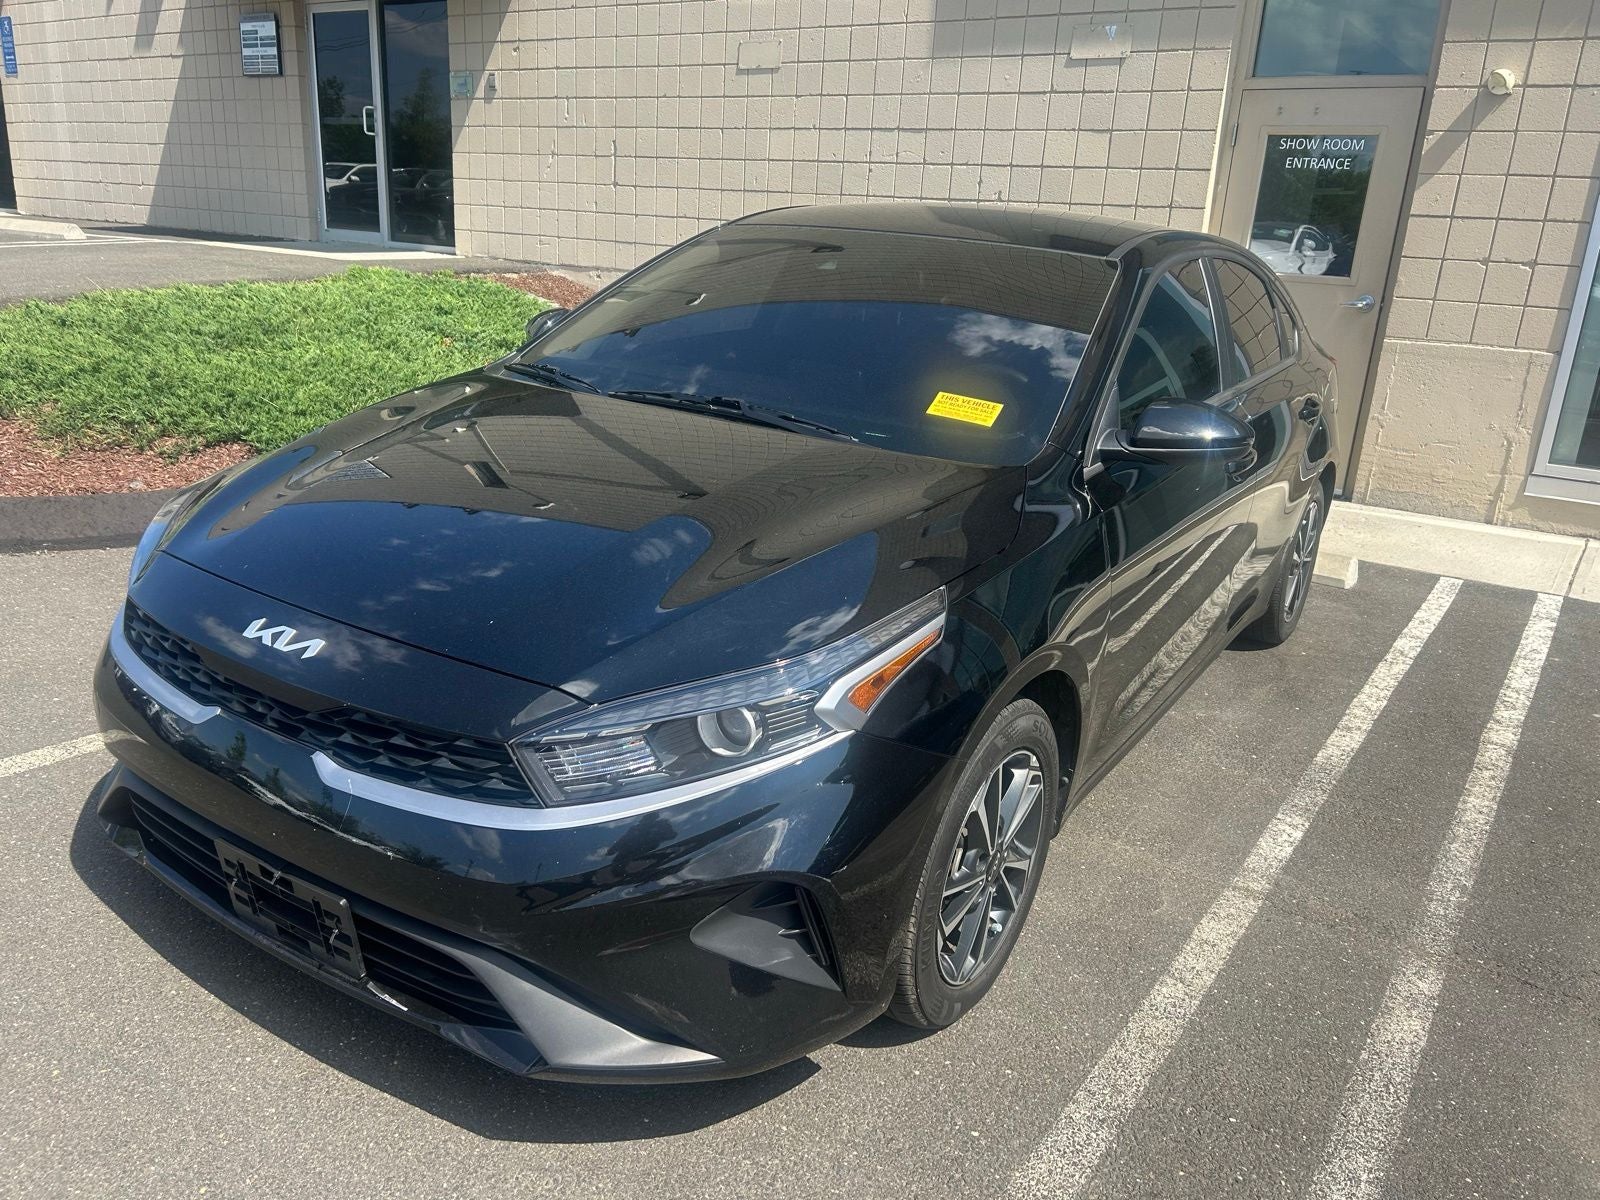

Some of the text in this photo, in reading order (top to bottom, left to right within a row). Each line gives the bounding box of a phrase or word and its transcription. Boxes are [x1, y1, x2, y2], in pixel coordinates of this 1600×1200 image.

[1279, 138, 1365, 151] SHOW ROOM
[1285, 157, 1352, 170] ENTRANCE
[941, 394, 960, 403] THIS
[962, 398, 998, 411] VEHICLE
[242, 617, 326, 659] KIA
